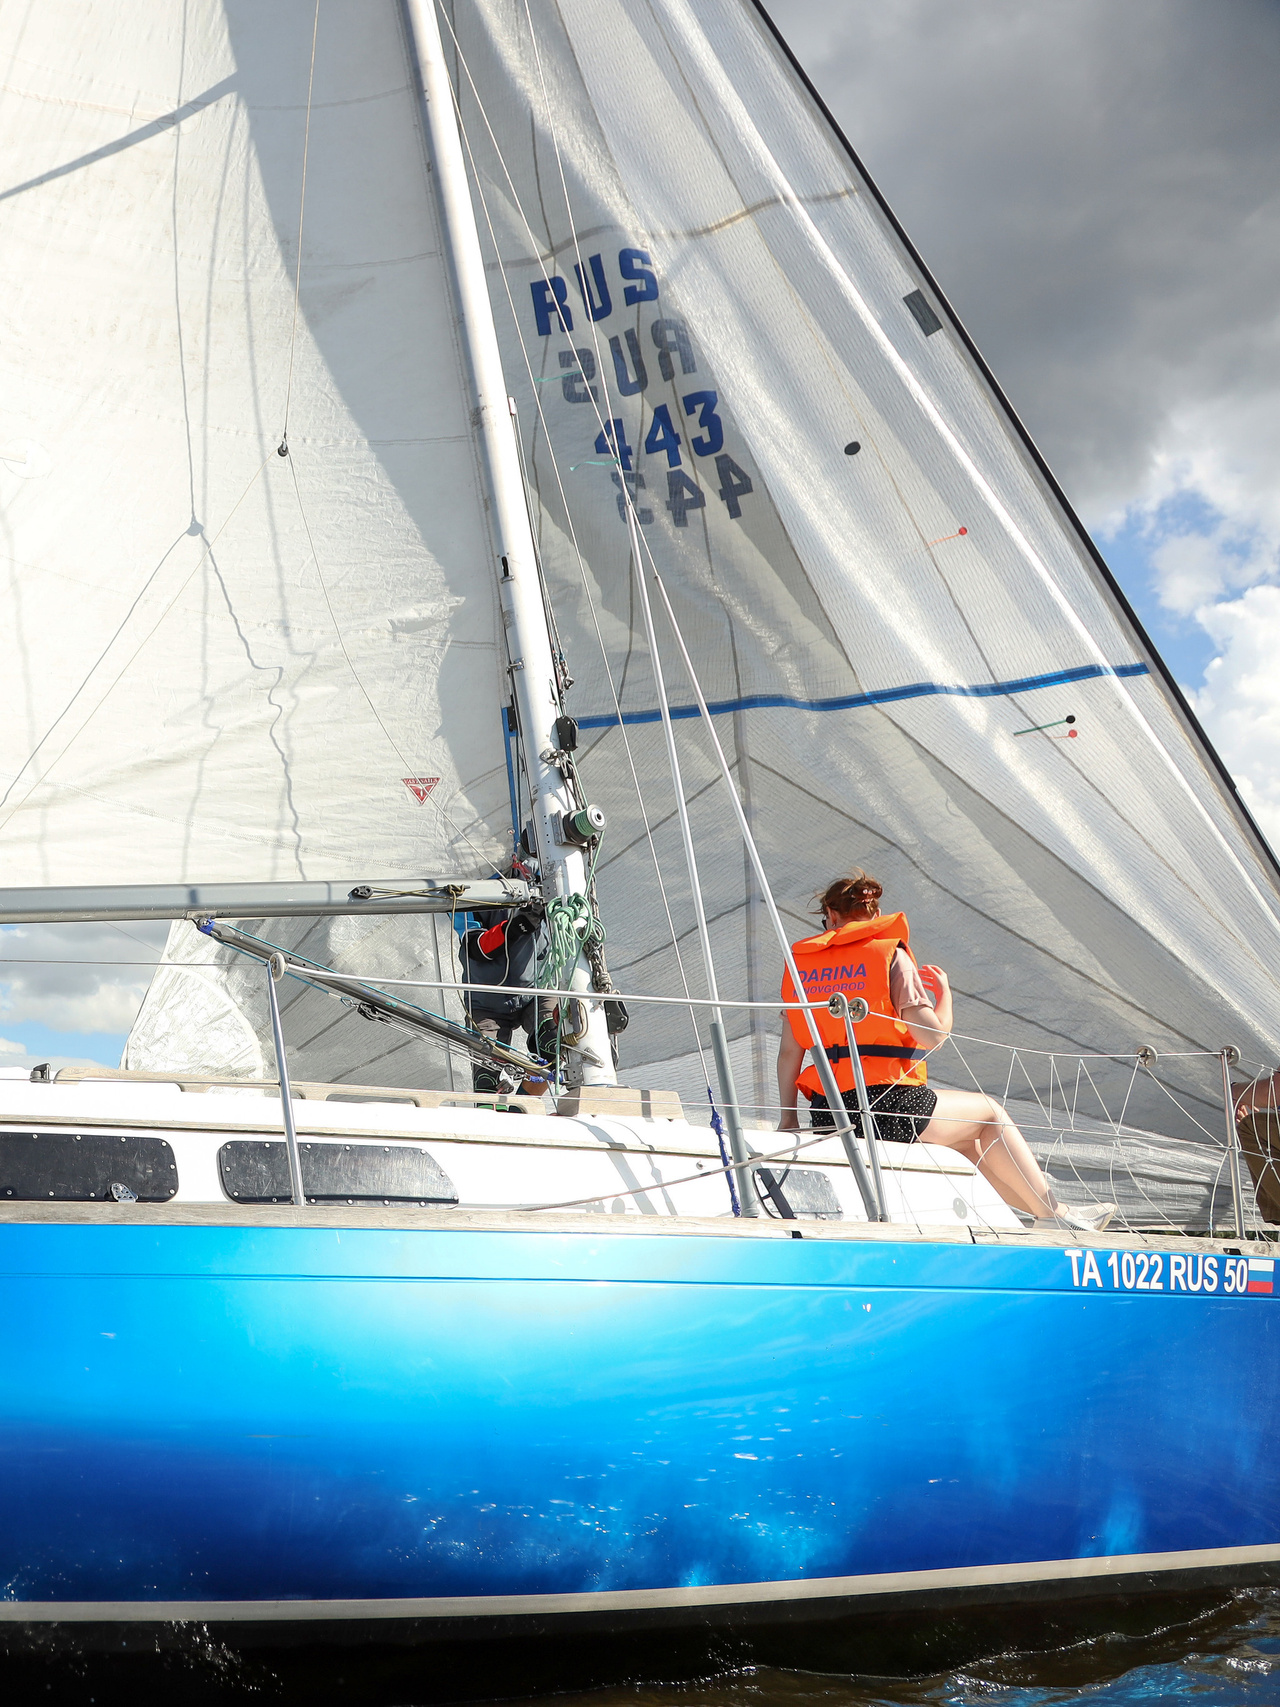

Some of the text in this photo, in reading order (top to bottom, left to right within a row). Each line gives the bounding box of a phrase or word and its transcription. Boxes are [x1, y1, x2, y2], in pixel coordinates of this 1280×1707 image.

[530, 248, 659, 336] RUS
[594, 390, 724, 471] 443
[797, 963, 867, 984] DARINA
[1064, 1249, 1248, 1293] TA 1022 RUS 50
